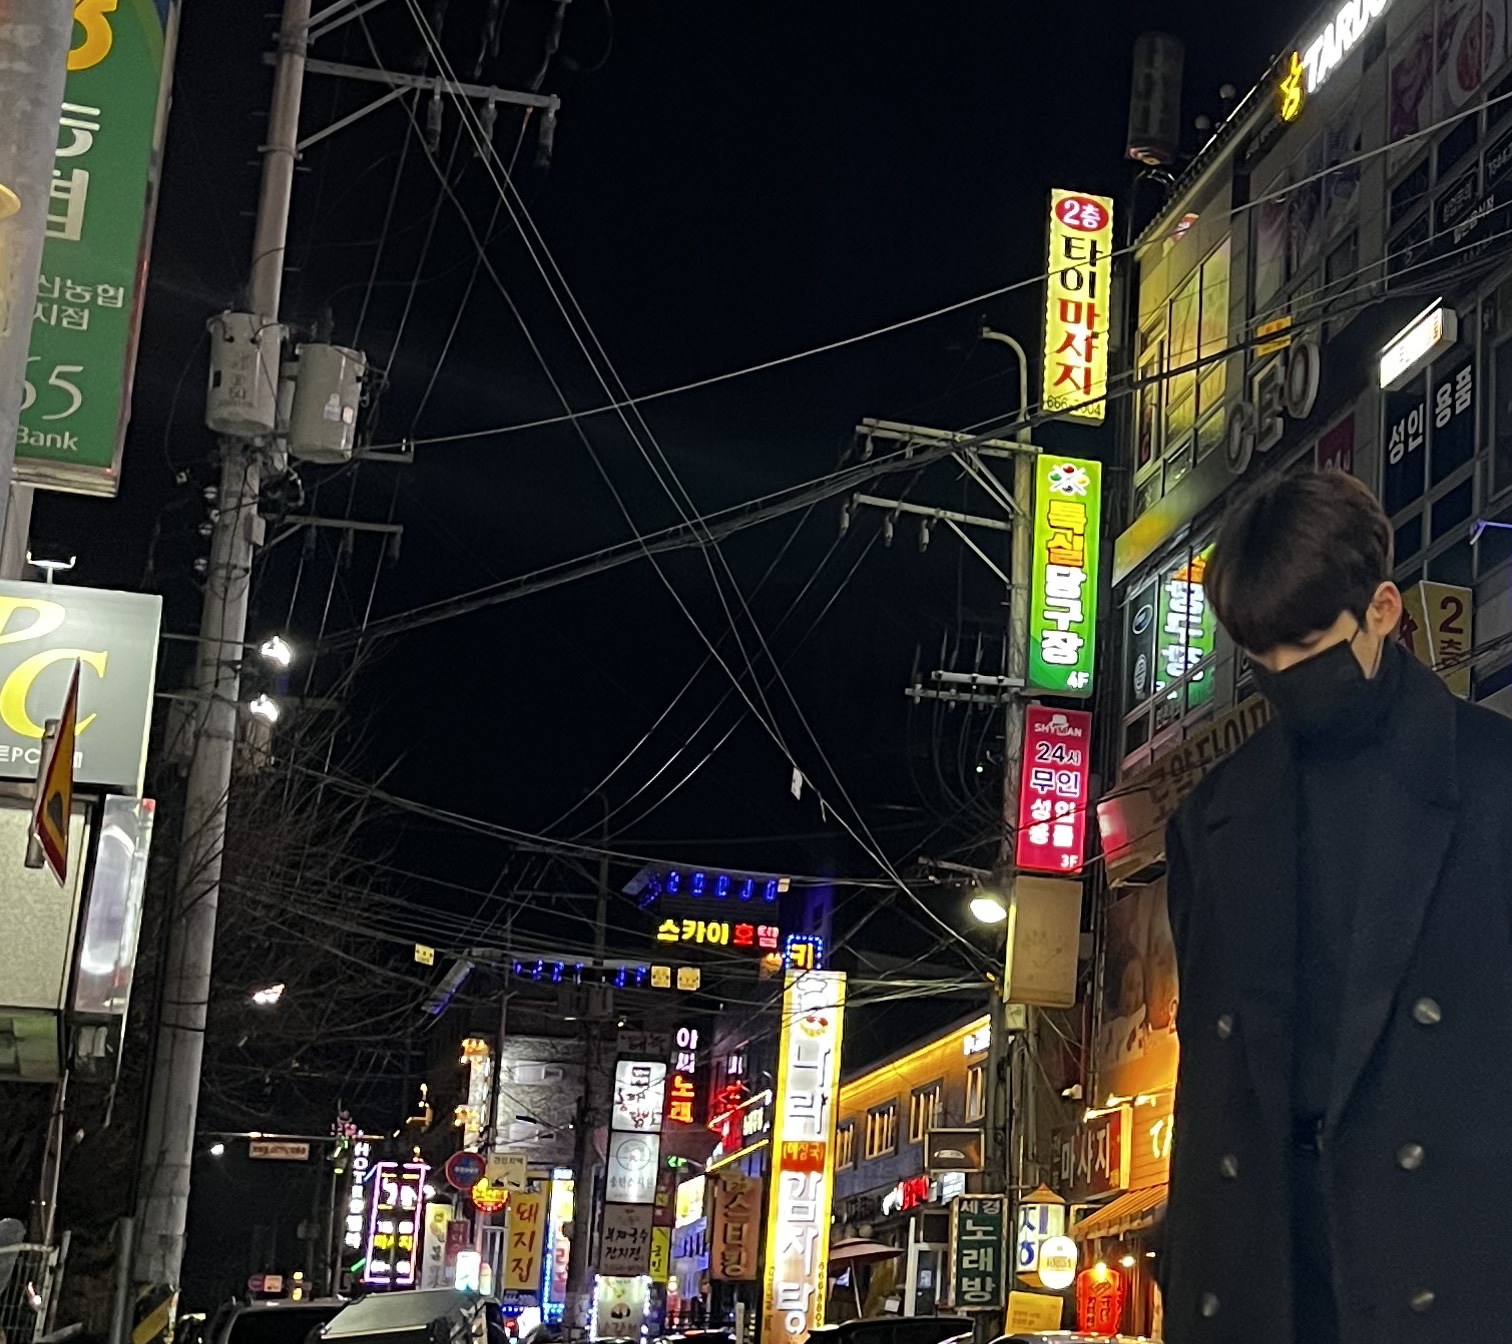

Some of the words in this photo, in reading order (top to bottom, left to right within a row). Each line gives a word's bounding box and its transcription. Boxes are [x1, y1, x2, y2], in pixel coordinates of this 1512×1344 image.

[1063, 199, 1101, 230] 2층
[1053, 233, 1104, 396] 타이마사지
[1388, 403, 1425, 465] 성인
[1435, 364, 1473, 429] 용품
[1066, 670, 1090, 690] 4F
[1036, 743, 1082, 766] 24시
[1031, 769, 1079, 796] 무인
[1061, 854, 1079, 868] 3F
[961, 1218, 999, 1303] 노래방
